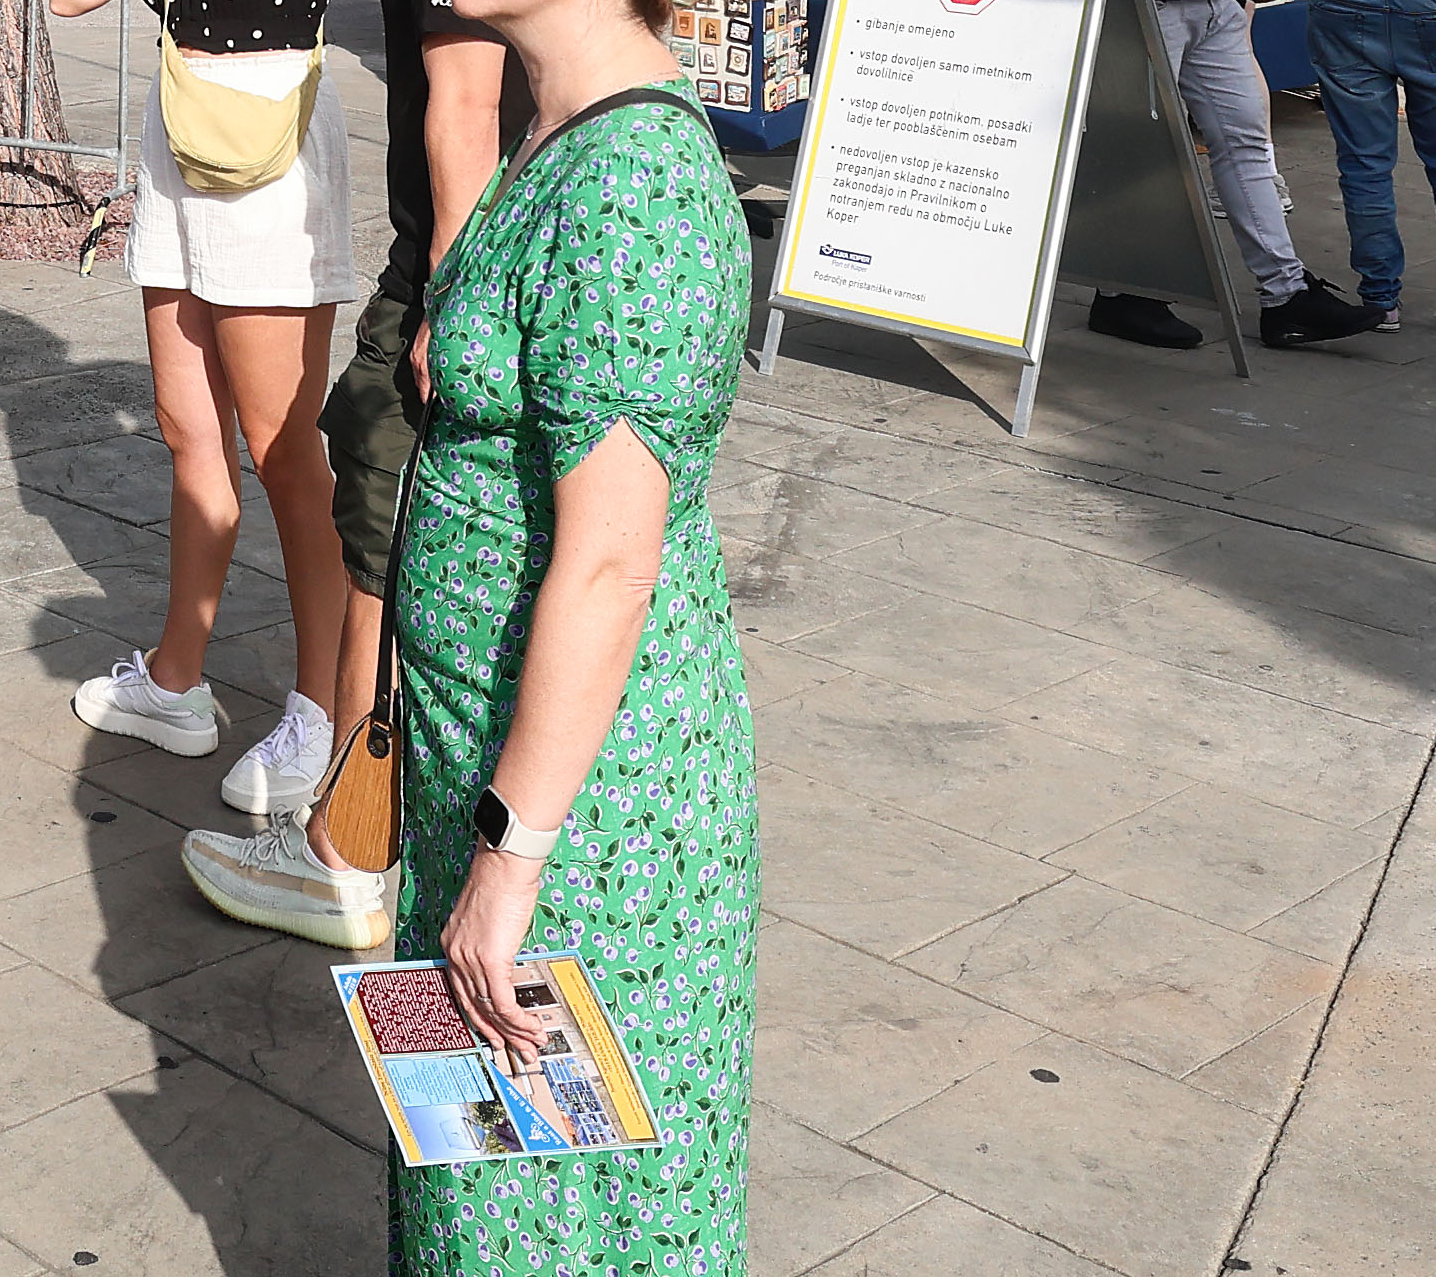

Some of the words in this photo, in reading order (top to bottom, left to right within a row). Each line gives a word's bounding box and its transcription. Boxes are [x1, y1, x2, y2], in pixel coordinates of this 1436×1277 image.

[865, 17, 905, 33] gibanje
[906, 22, 956, 40] omejeno
[859, 50, 888, 63] vstop
[890, 53, 936, 68] dovoljen
[938, 61, 969, 73] samo
[971, 65, 1032, 81] imetnikom
[846, 111, 873, 127] ladje
[875, 116, 891, 128] ter
[892, 120, 969, 141] pooblaščenim
[972, 133, 1017, 148] osebam
[849, 97, 878, 111] vstop
[880, 100, 926, 117] dovoljen
[928, 109, 983, 126] potnikom,
[986, 118, 1032, 133] posadki
[835, 161, 890, 179] preganjan
[892, 169, 937, 187] skladno
[938, 179, 946, 189] z
[947, 180, 1010, 199] nacionalno
[839, 145, 898, 163] nedovoljen
[900, 156, 930, 171] vstop
[930, 161, 943, 173] je
[945, 161, 999, 180] kazensko
[832, 177, 894, 197] zakonodajo
[896, 189, 907, 199] in
[909, 188, 977, 211] Pravilnikom
[979, 203, 987, 213] o
[825, 207, 859, 223] Koper
[829, 193, 885, 211] notranjem
[887, 204, 913, 217] redu
[915, 209, 929, 220] na
[932, 211, 981, 230] območju
[983, 218, 1013, 235] Luke
[812, 269, 847, 286] Področje
[847, 279, 892, 295] pristaniške
[893, 289, 926, 302] varnosti
